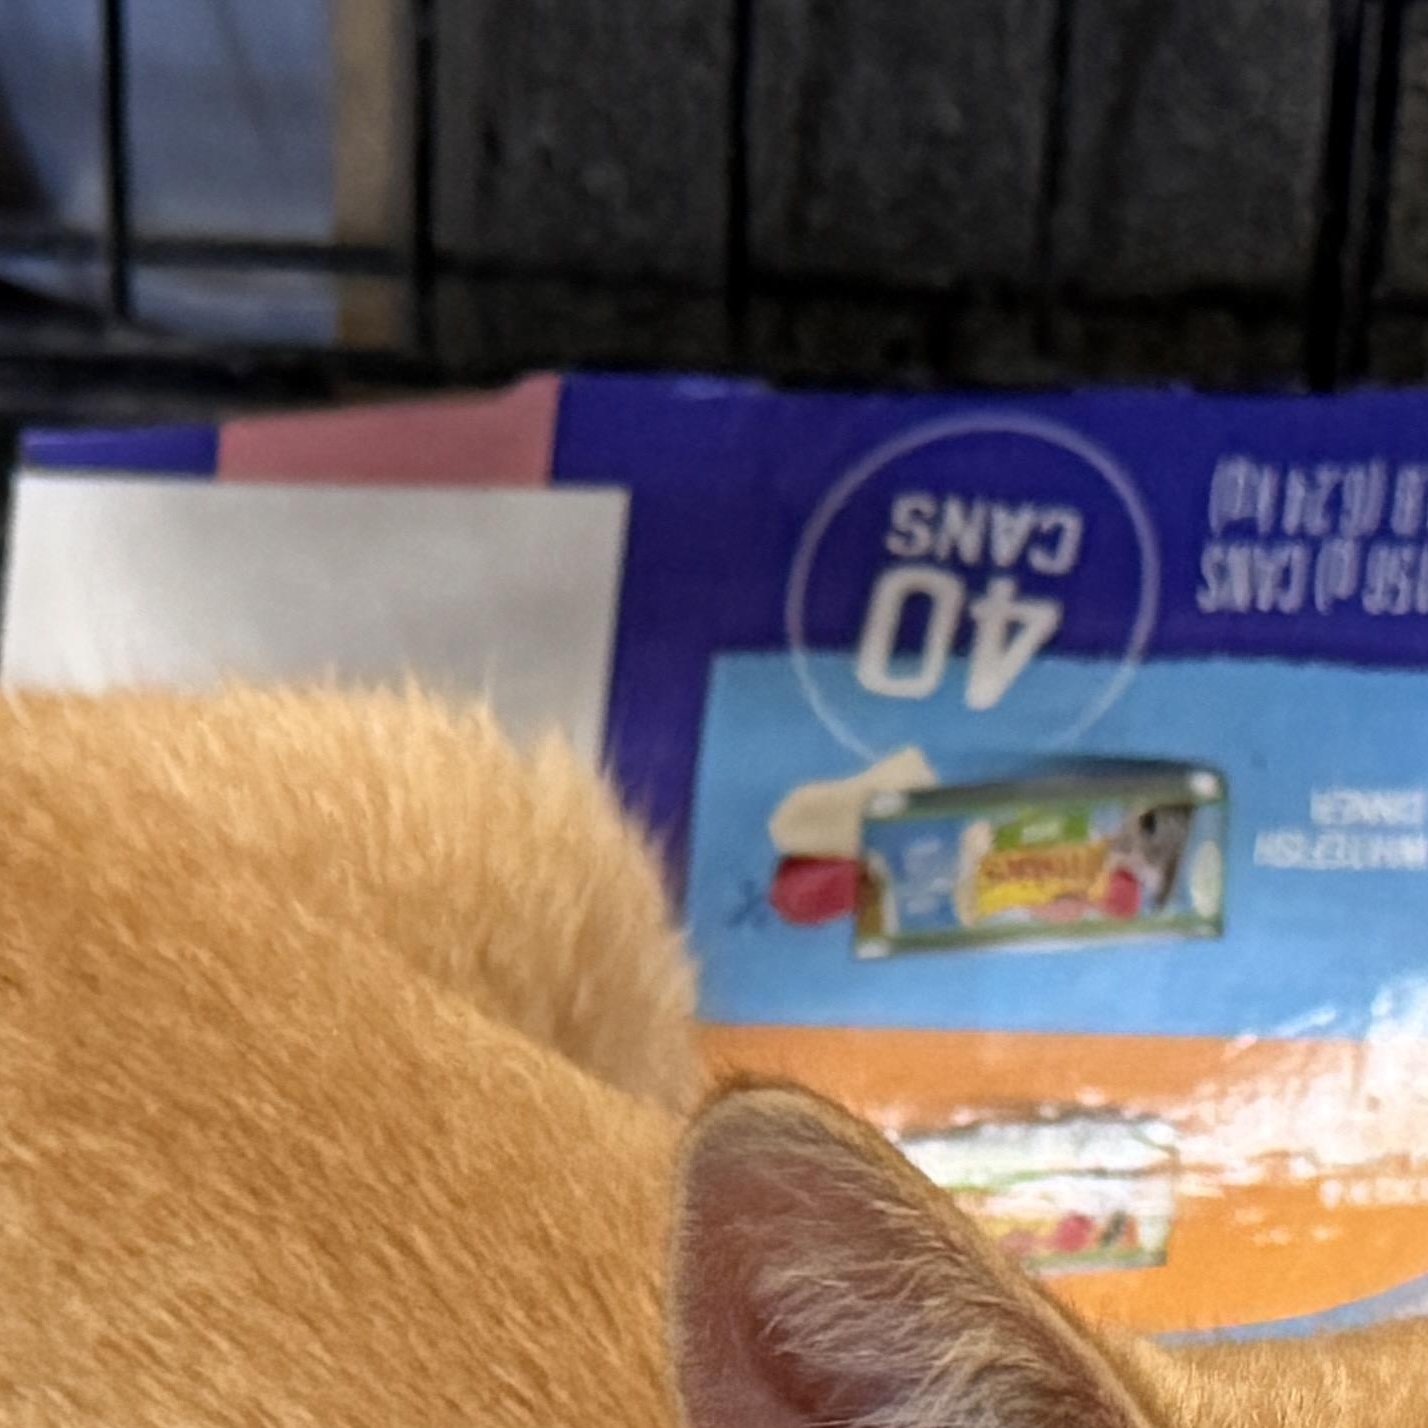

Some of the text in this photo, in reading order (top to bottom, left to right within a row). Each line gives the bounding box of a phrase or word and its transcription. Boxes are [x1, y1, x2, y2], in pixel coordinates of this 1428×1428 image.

[884, 490, 1084, 577] CANS
[1196, 540, 1309, 612] CANS
[855, 563, 1064, 711] 40
